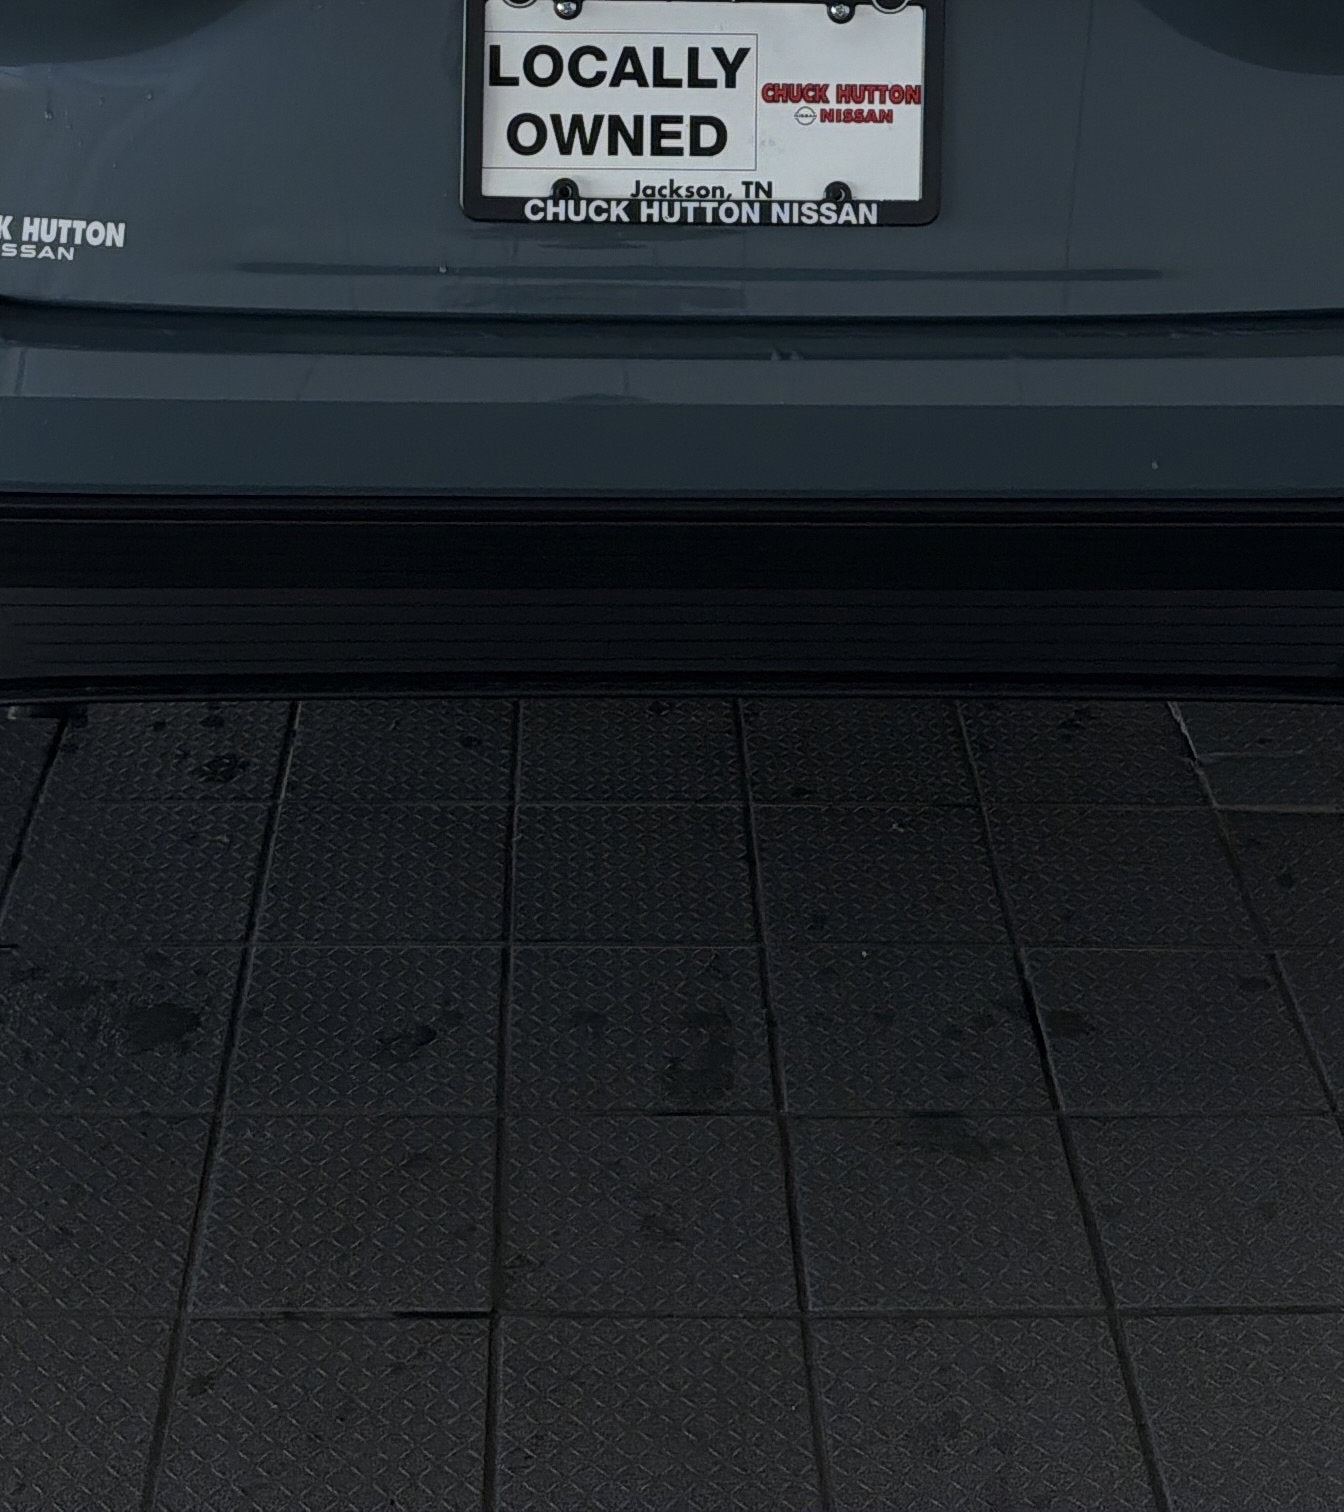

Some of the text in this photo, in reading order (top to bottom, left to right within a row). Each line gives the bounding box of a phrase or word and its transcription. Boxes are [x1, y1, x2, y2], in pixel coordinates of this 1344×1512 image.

[488, 44, 751, 89] LOCALLY
[761, 83, 922, 105] CHUCK HUTTON
[819, 108, 894, 124] NISSAN
[506, 113, 728, 157] OWNED
[630, 179, 773, 200] Jackson, TN
[524, 199, 878, 225] CHUCK HUTTON NISSAN
[21, 216, 126, 248] HUTTON
